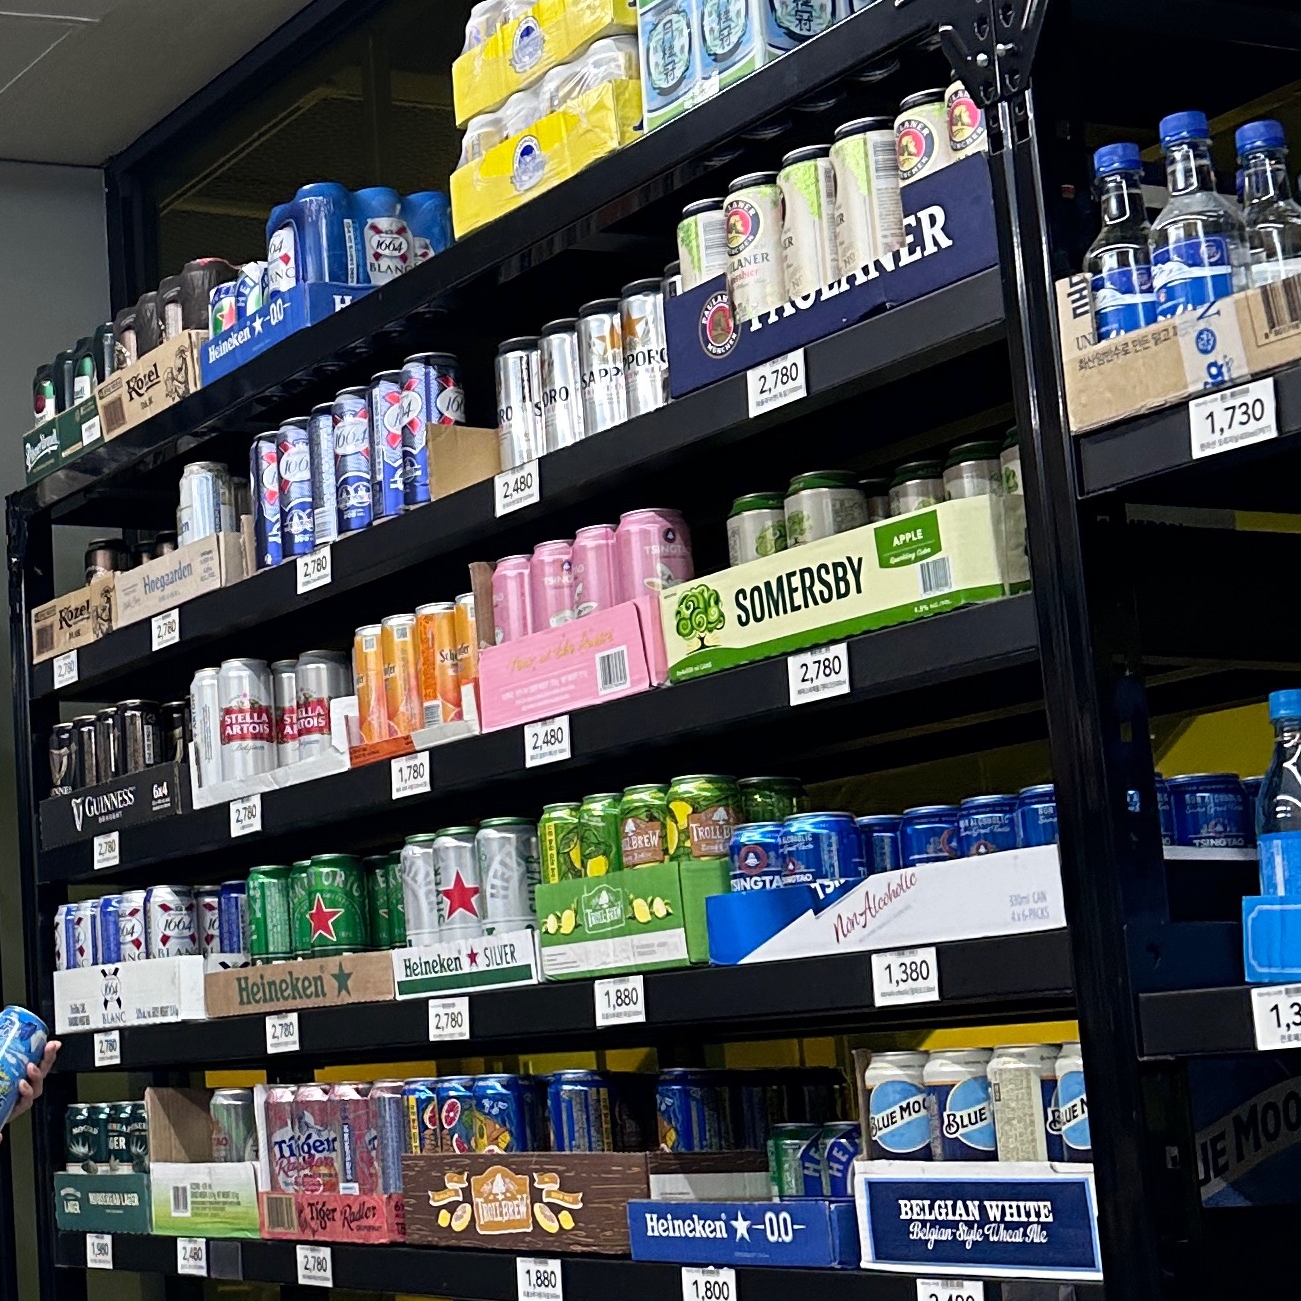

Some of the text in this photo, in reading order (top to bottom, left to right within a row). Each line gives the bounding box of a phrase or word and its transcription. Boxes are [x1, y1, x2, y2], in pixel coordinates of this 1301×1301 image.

[209, 320, 252, 364] Heineken
[759, 361, 799, 396] 2,780
[1205, 398, 1265, 437] 1,730
[502, 475, 533, 500] 2,480
[892, 528, 924, 548] APPLE
[143, 563, 194, 596] Hoegaarden
[303, 555, 328, 579] 2,780
[734, 554, 865, 628] SOMERSBY
[799, 654, 843, 684] 2,780
[224, 712, 269, 725] STELLA
[225, 722, 270, 735] ARTOIS
[531, 726, 564, 752] 2,480
[398, 763, 425, 784] 1,780
[85, 786, 135, 818] GUINNESS
[164, 918, 193, 932] 1664
[403, 943, 518, 978] Heineken SILVER
[883, 960, 930, 986] 1,380
[236, 971, 326, 1006] Heineken
[603, 987, 639, 1009] 1,880
[434, 1011, 463, 1032] 2,780
[944, 1106, 988, 1136] BLUE
[307, 1201, 337, 1230] Tiger
[898, 1199, 1054, 1223] BELGIAN WHITE
[645, 1213, 727, 1240] Heineken
[984, 1223, 1024, 1243] Wheat
[1025, 1222, 1049, 1244] Ale
[303, 1256, 328, 1275] 2,780
[525, 1269, 557, 1289] 1,880
